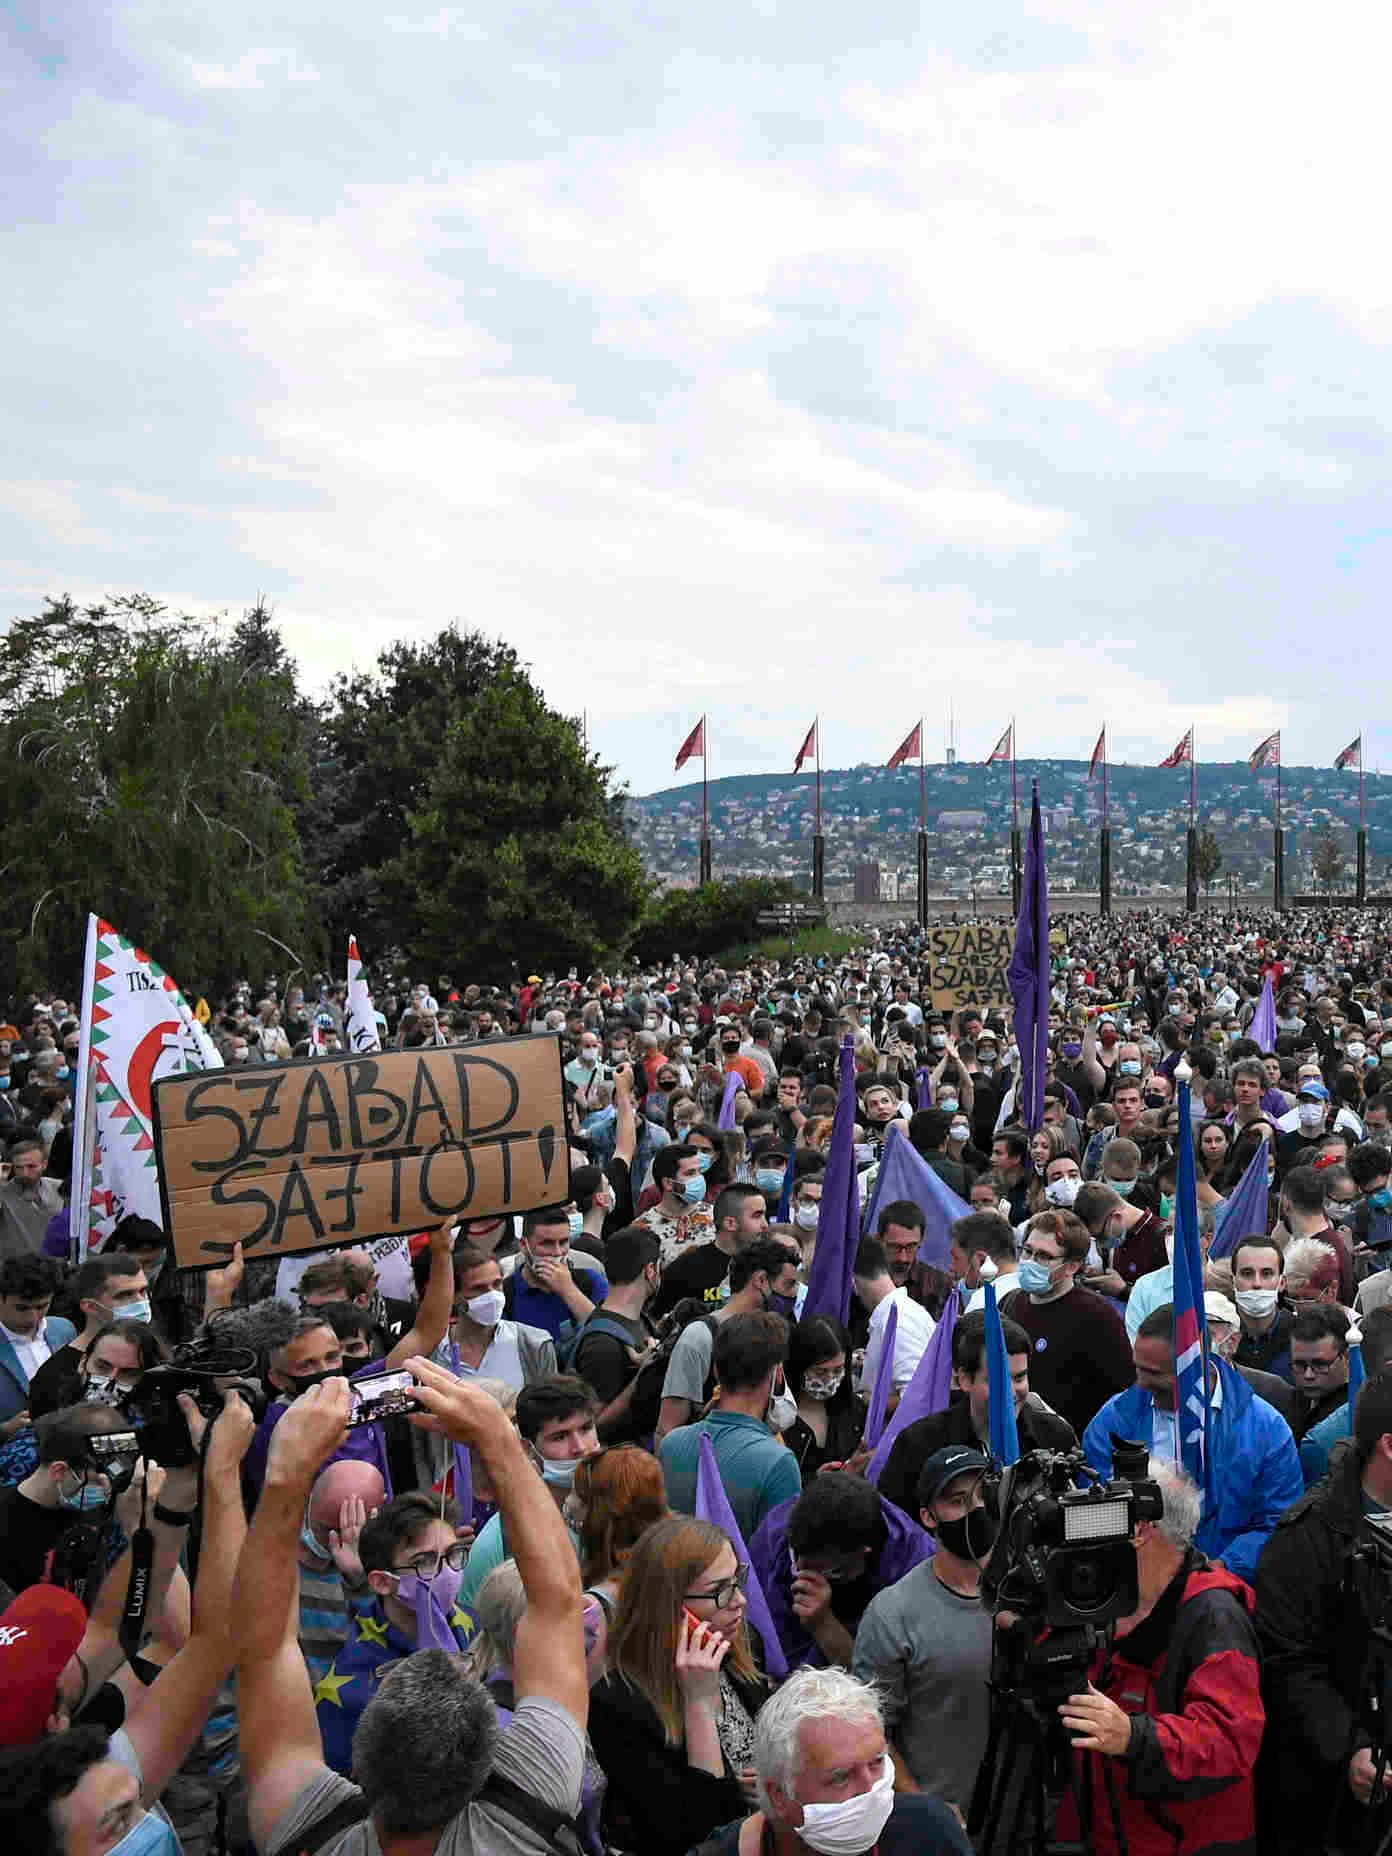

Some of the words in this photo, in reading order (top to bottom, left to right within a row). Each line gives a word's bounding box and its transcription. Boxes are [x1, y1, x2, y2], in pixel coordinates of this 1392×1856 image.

[931, 928, 1014, 956] SZABA
[932, 965, 1009, 990] SZABA
[185, 1053, 519, 1172] SZABAD
[127, 1566, 148, 1617] LUMIX
